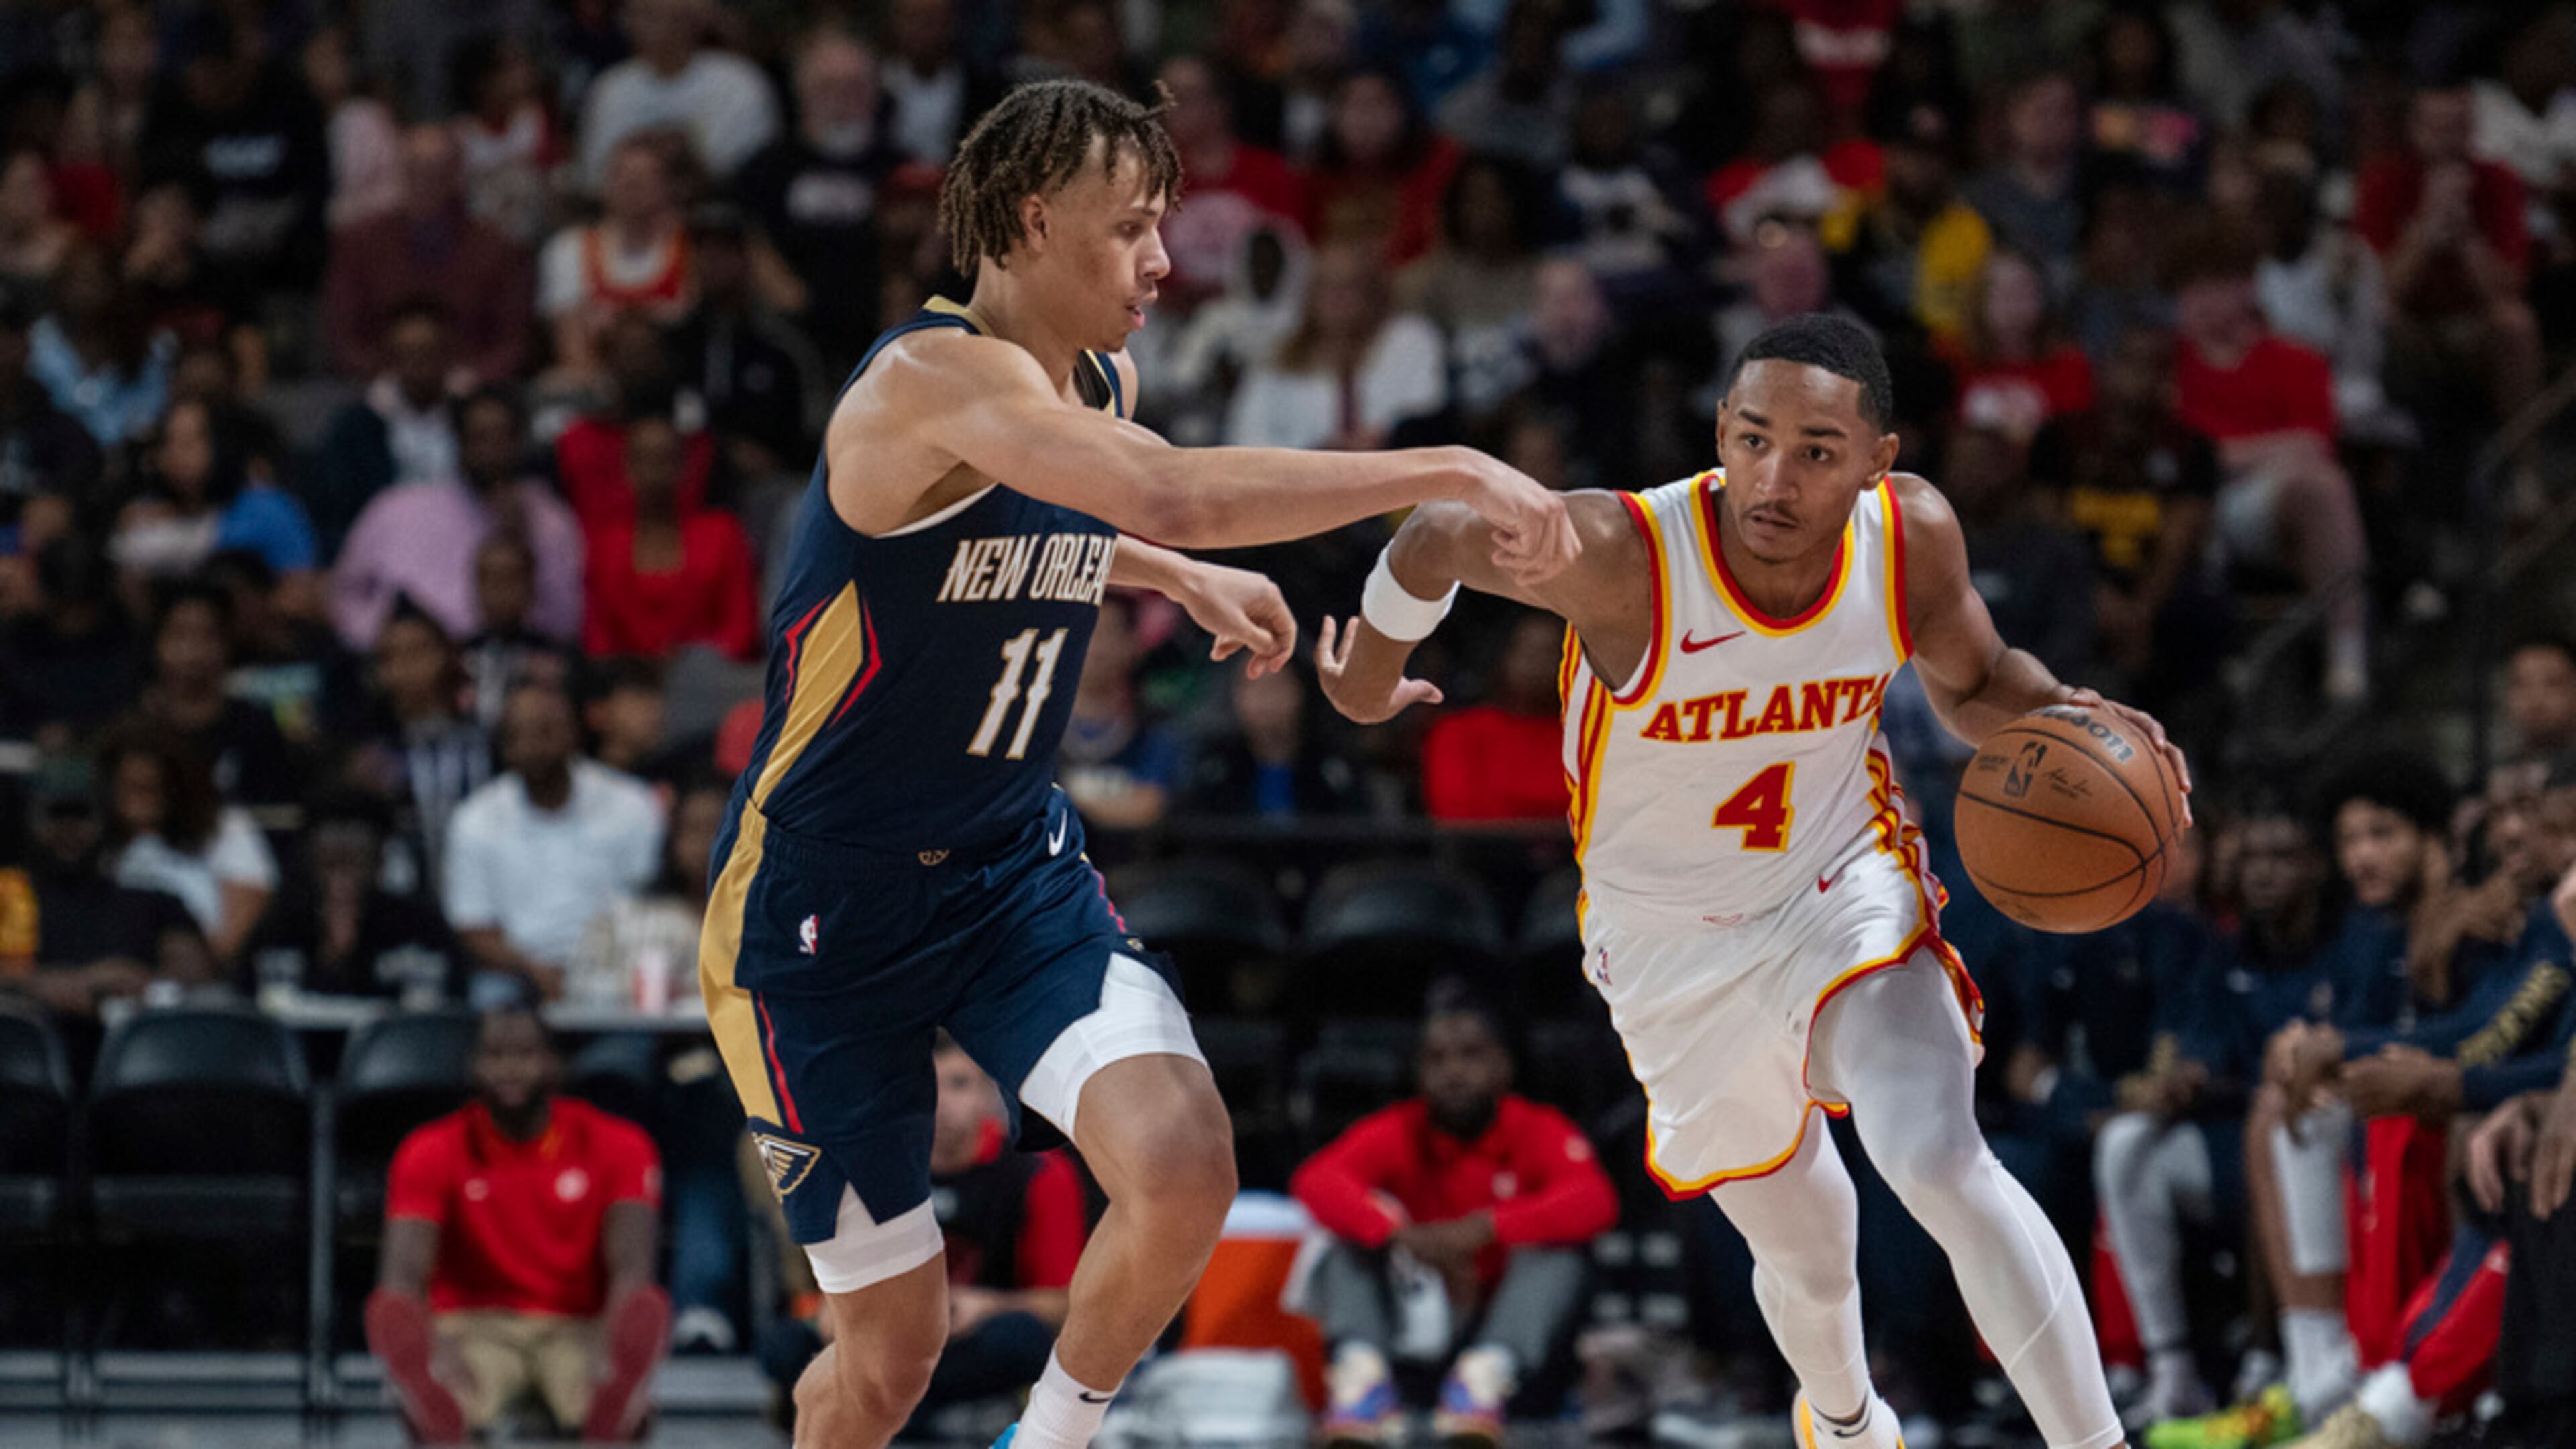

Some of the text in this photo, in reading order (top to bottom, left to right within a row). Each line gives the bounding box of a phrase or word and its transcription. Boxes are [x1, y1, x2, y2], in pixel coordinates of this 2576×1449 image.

[936, 534, 1041, 602] NEW
[966, 627, 1070, 761] 11
[1711, 760, 1796, 853] 4
